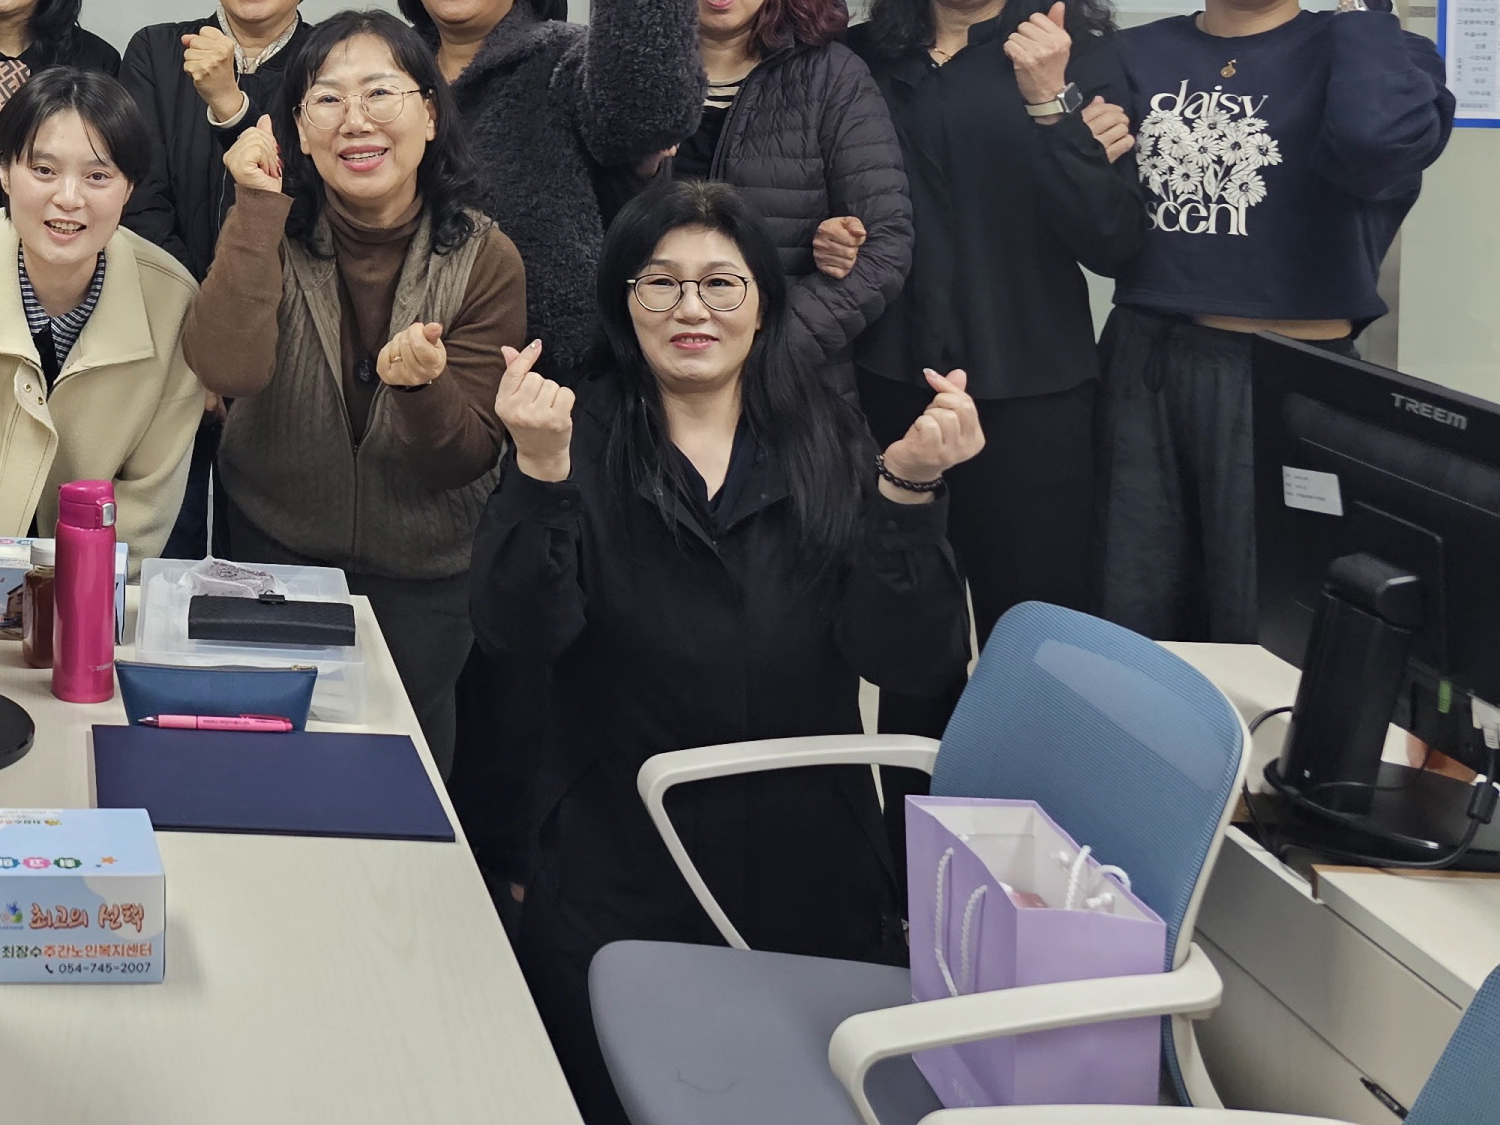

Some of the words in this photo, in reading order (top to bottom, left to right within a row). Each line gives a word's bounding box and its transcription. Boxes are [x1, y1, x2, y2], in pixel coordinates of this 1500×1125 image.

[1150, 79, 1269, 120] daisy
[1390, 392, 1468, 430] TREEM
[29, 902, 90, 930] 최고의
[98, 902, 146, 933] 선택
[58, 961, 152, 974] 054-745-2007
